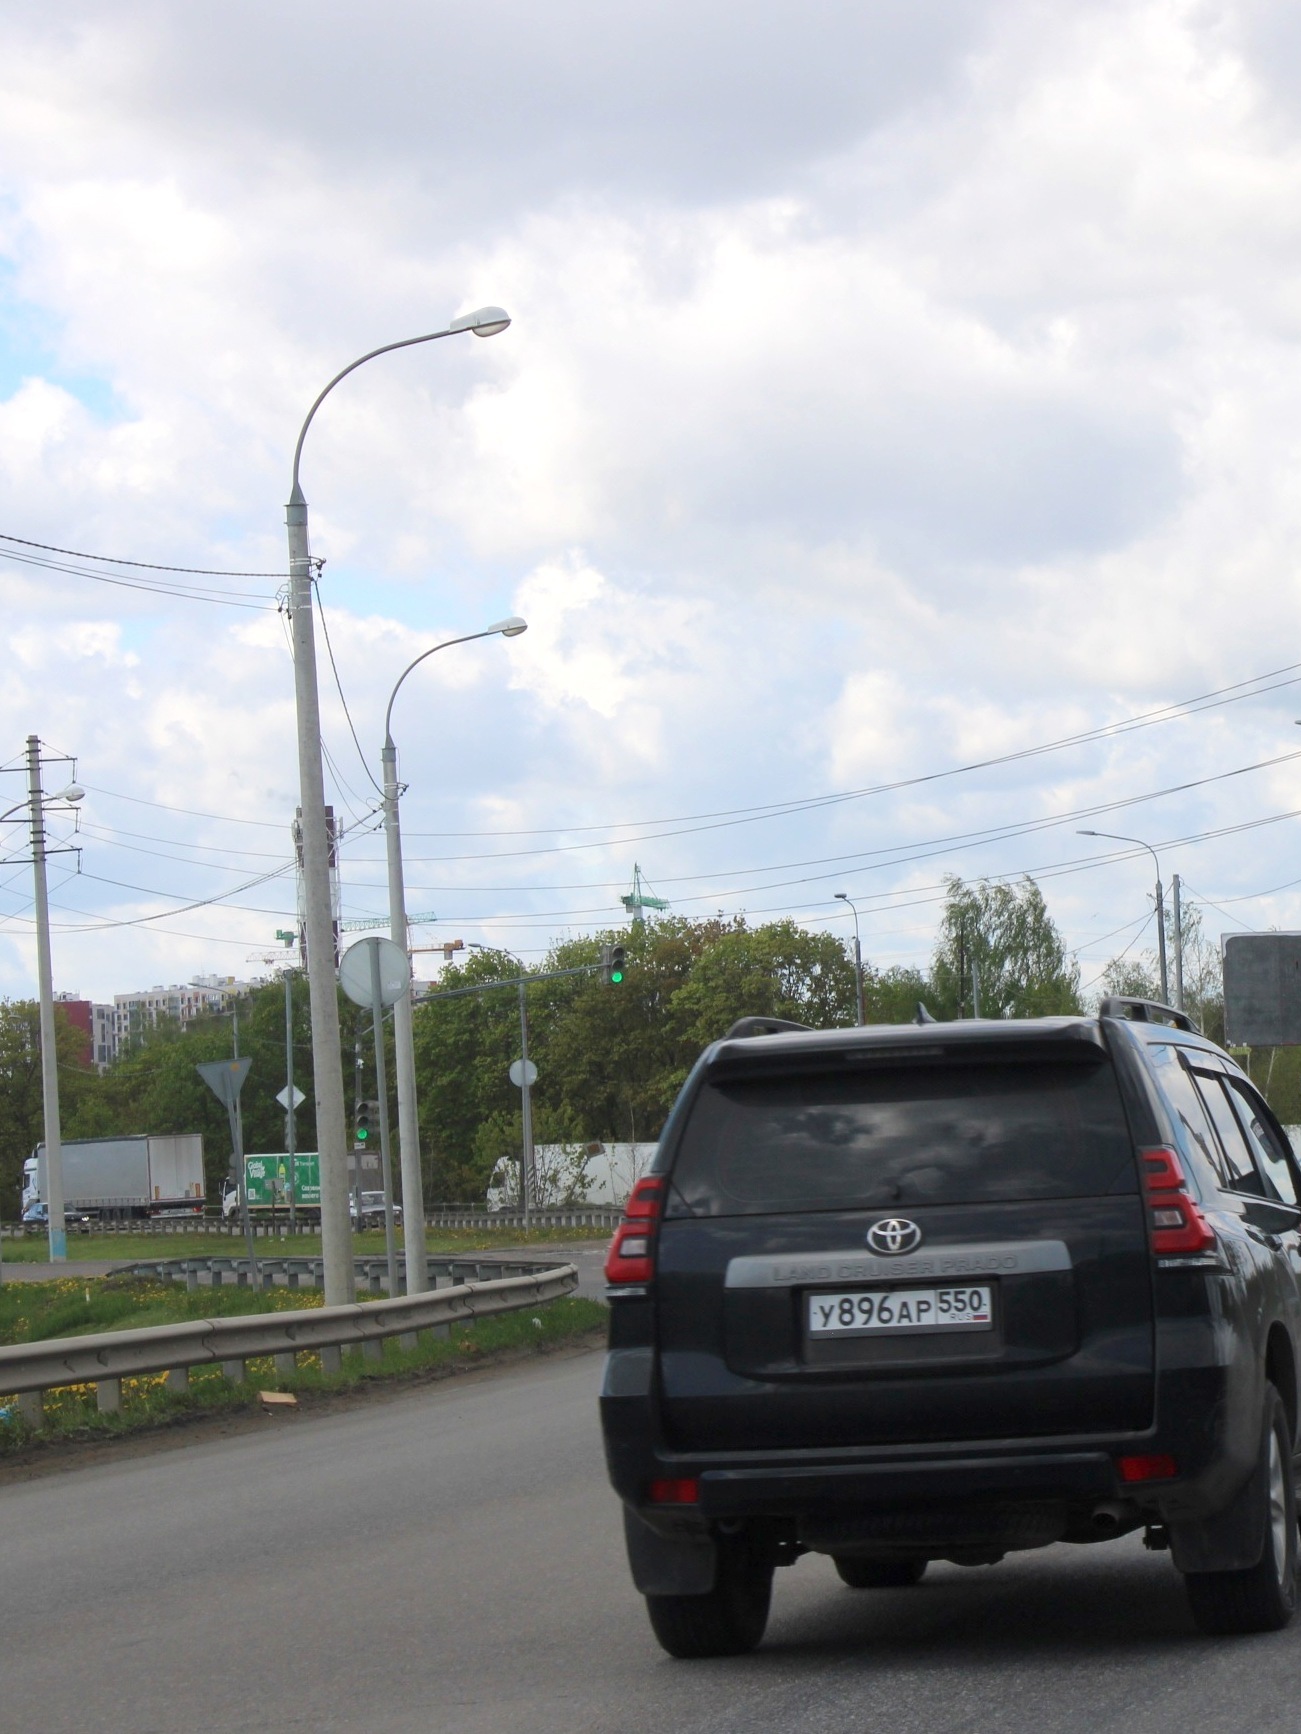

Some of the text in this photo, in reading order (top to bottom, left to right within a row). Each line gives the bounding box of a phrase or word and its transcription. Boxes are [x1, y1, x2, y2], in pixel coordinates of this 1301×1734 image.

[772, 1254, 1019, 1282] LAND CRUISER PRADO
[938, 1289, 983, 1314] 550
